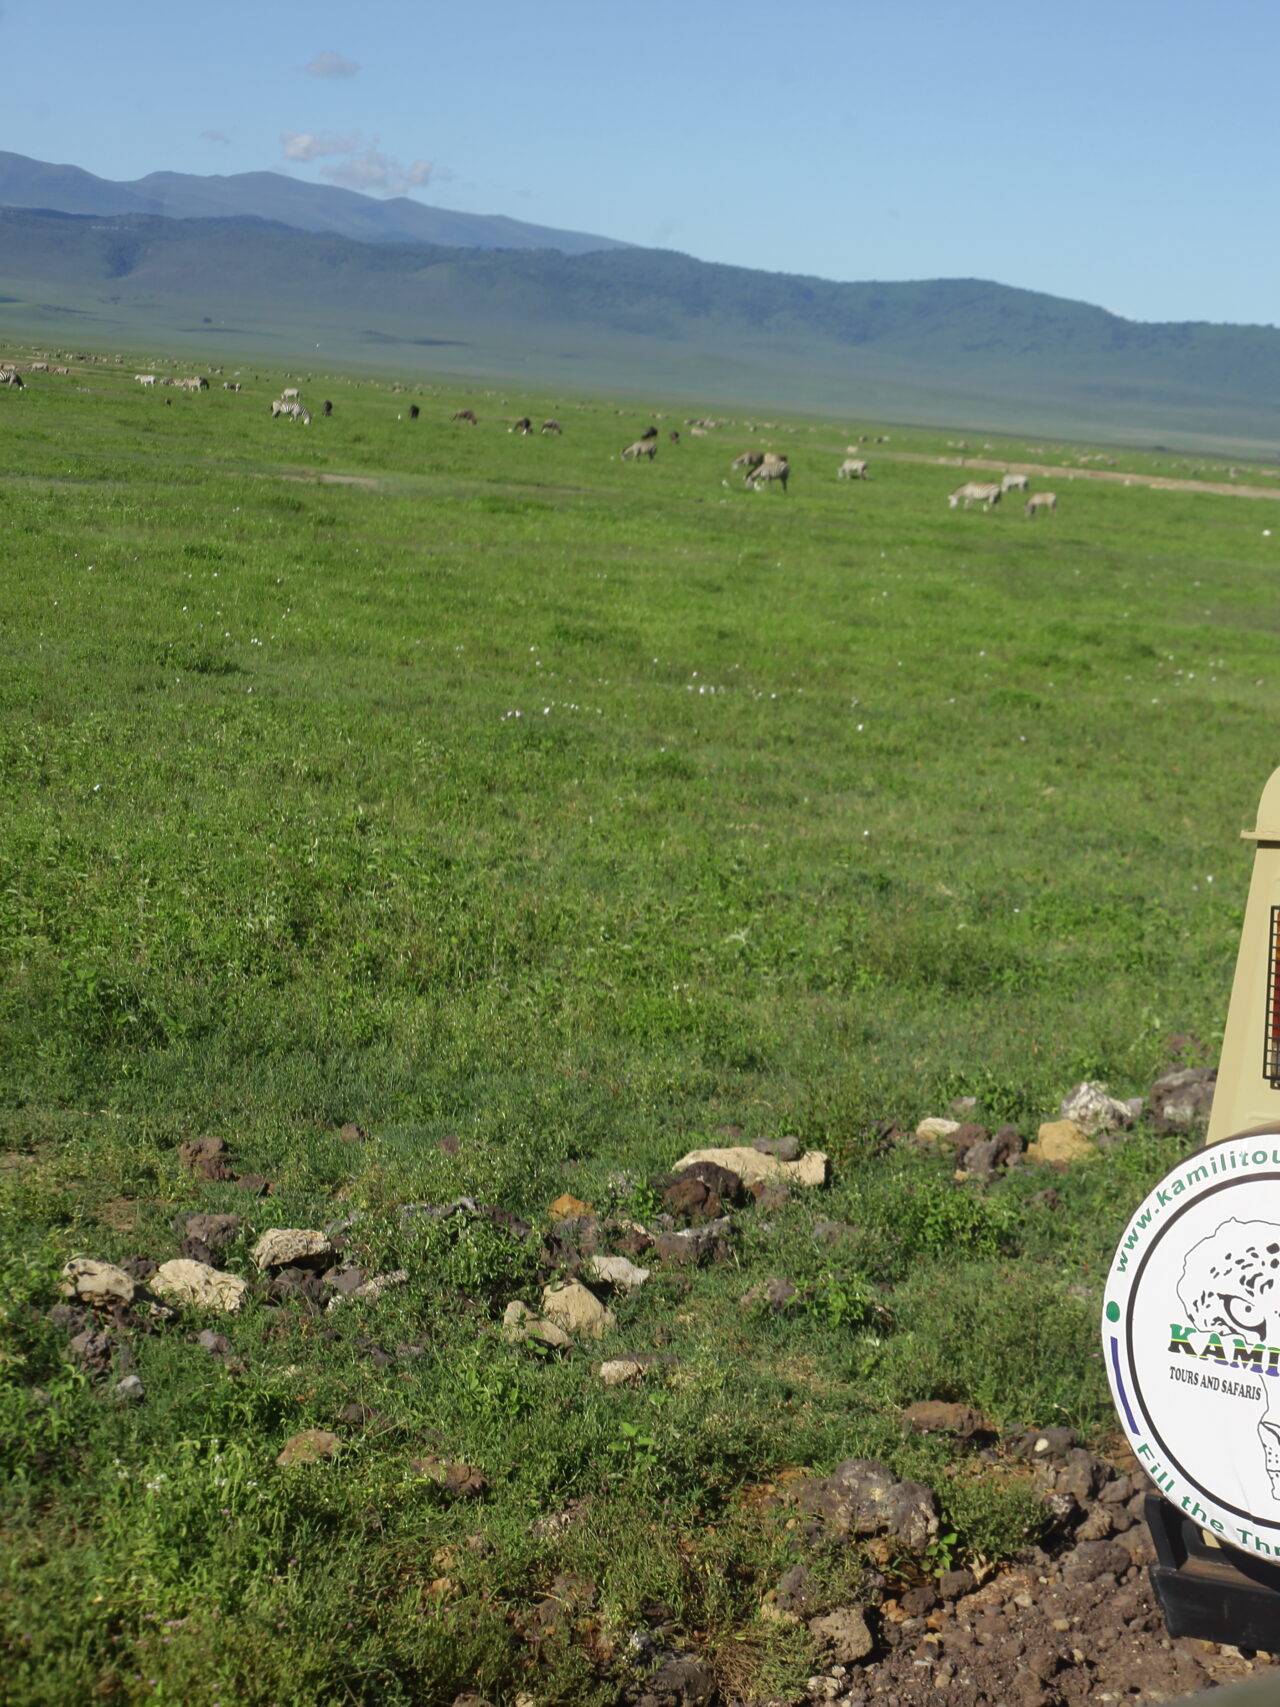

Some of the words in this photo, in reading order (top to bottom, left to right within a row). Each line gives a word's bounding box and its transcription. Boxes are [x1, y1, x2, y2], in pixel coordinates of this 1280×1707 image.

[1169, 1366, 1199, 1388] TOURS
[1200, 1373, 1220, 1393] AND
[1221, 1377, 1262, 1401] SAFARIS
[1136, 1443, 1175, 1494] Fill
[1181, 1495, 1225, 1533] the
